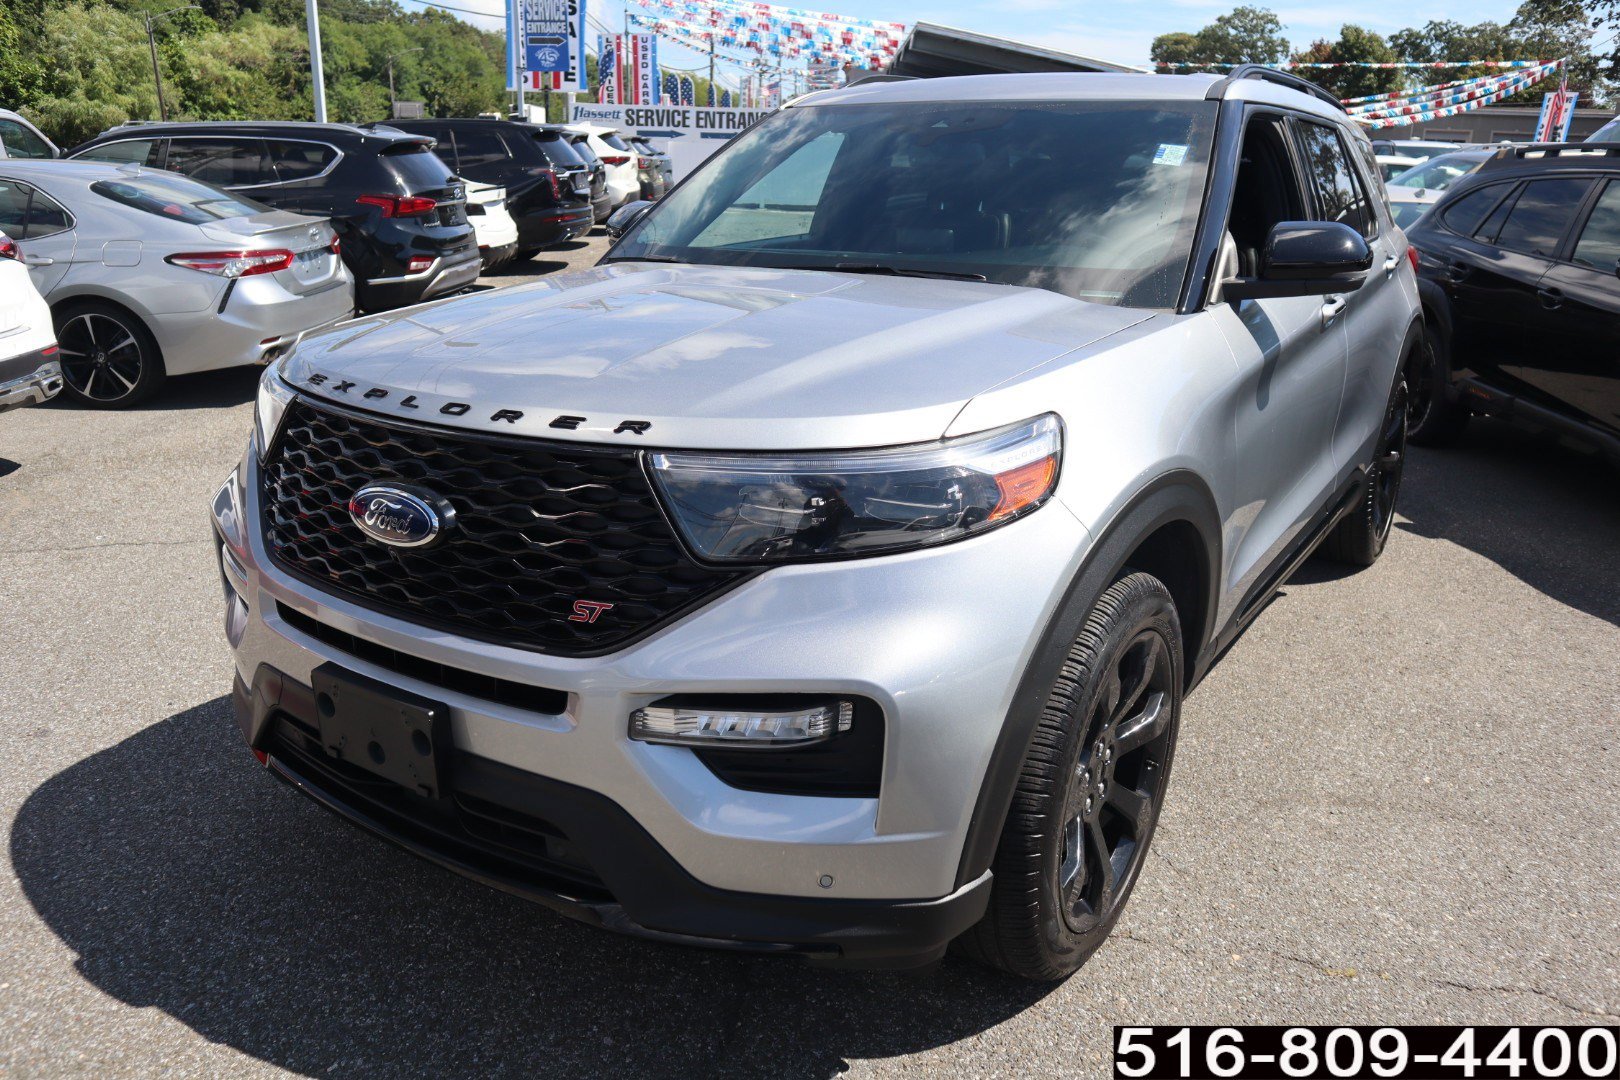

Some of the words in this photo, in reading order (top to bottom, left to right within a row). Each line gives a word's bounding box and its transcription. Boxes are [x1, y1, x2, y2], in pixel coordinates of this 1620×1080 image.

[526, 0, 567, 20] SERVICE
[526, 21, 567, 33] ENTRANCE
[606, 72, 614, 105] RICES
[641, 74, 650, 105] CARS
[573, 106, 621, 120] Hassett
[625, 108, 690, 127] SERVICE
[695, 111, 768, 129] ENTRAN
[308, 373, 652, 436] EXPLORER
[365, 498, 413, 535] Ford
[568, 600, 614, 623] ST
